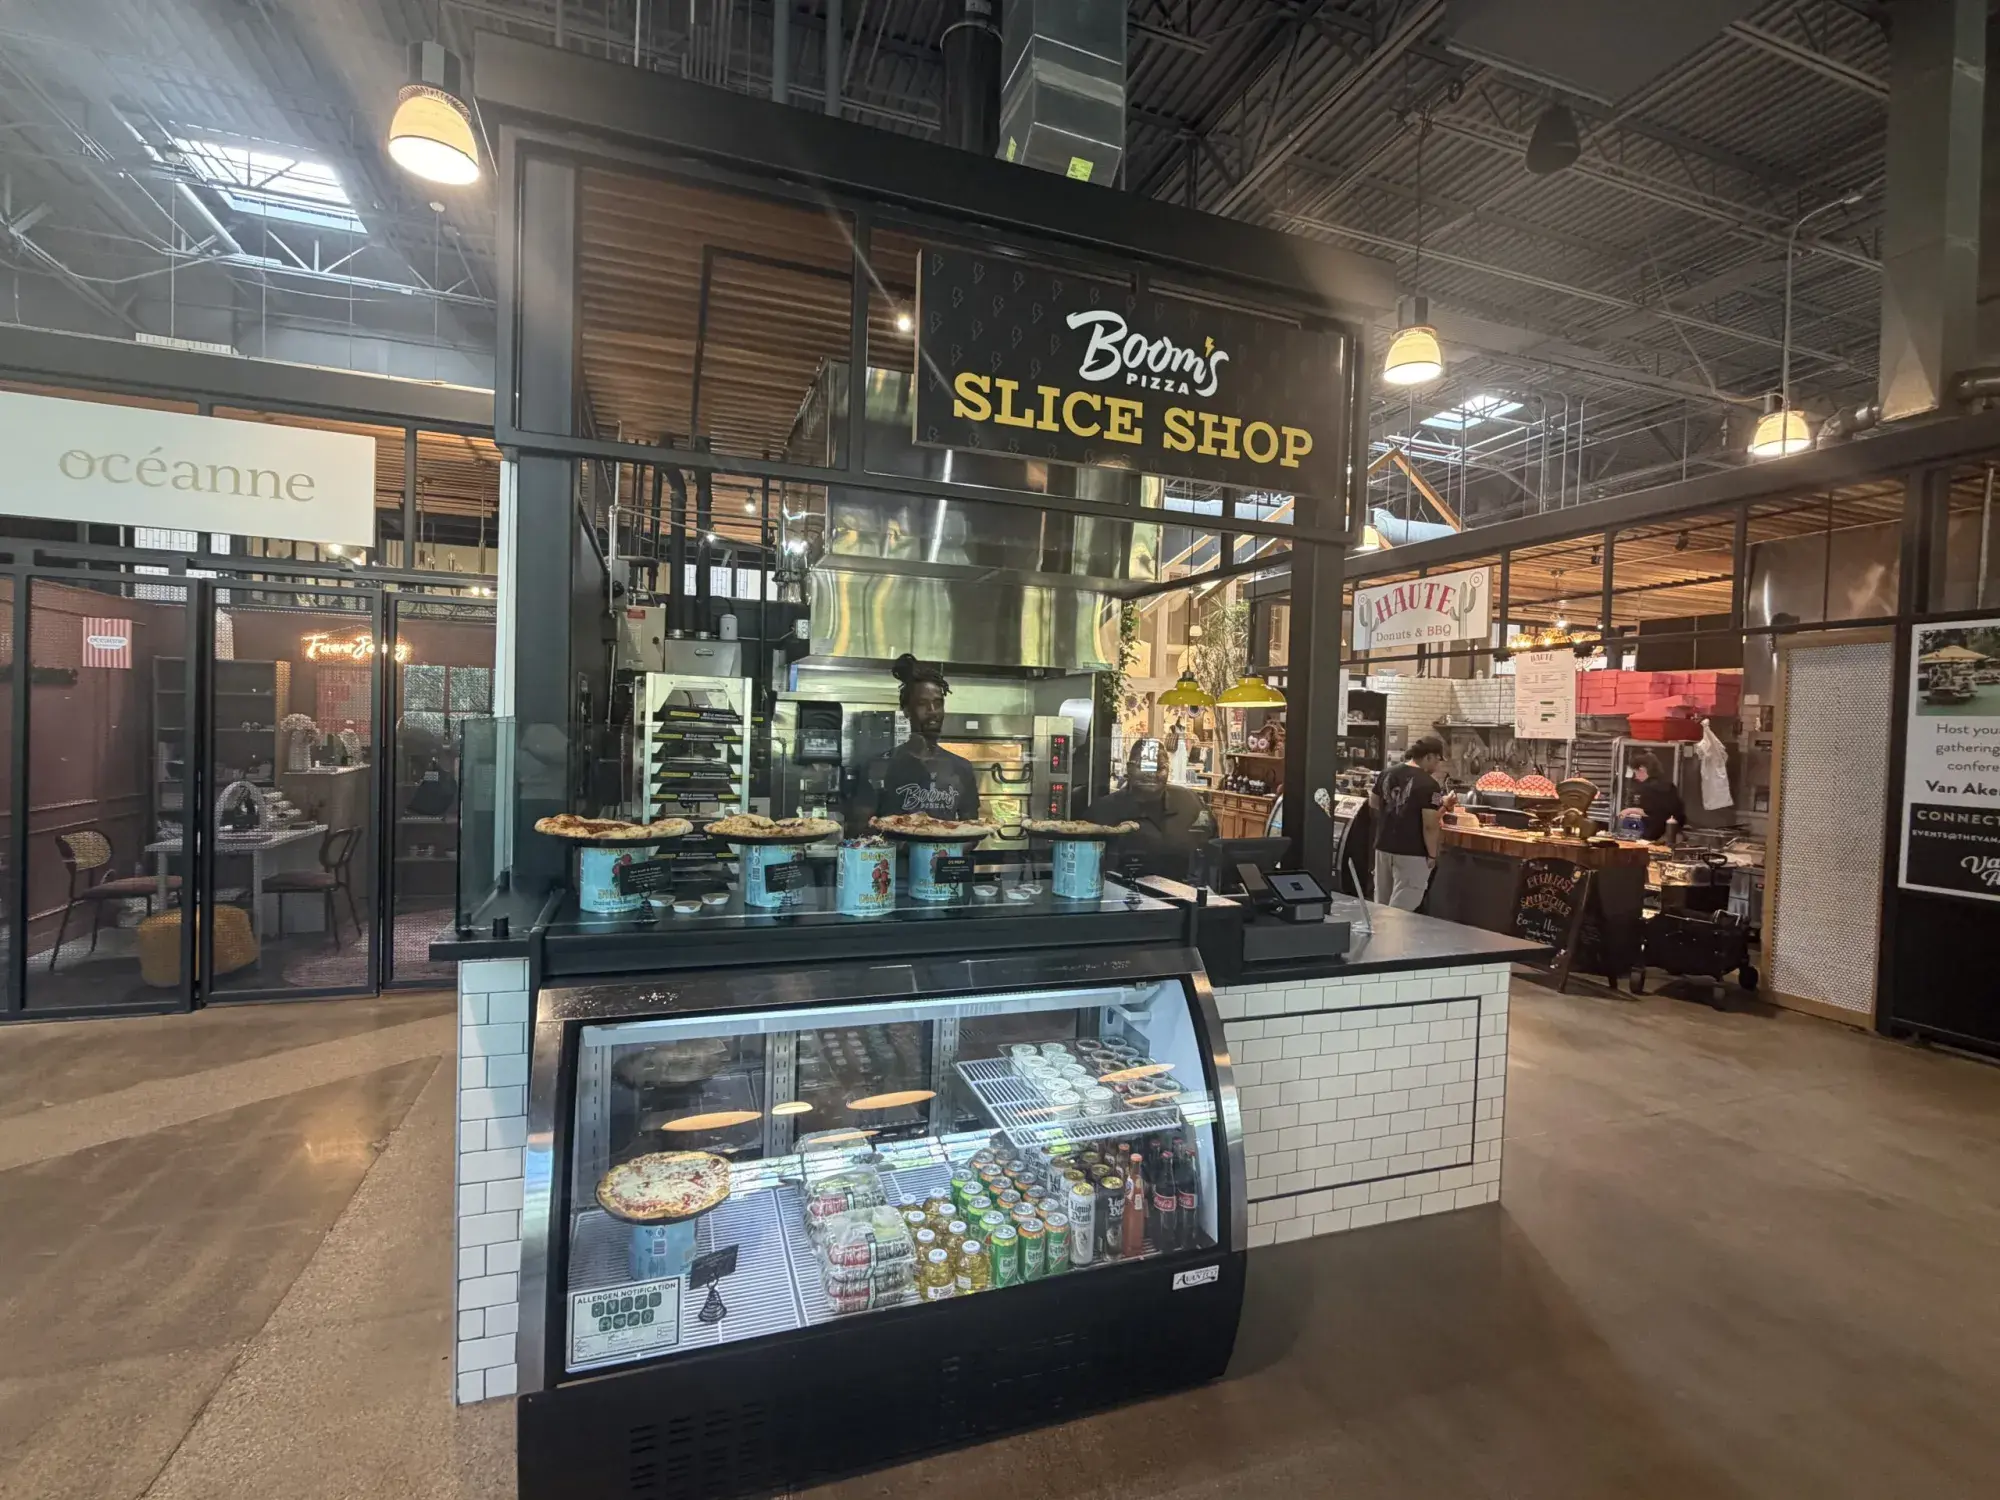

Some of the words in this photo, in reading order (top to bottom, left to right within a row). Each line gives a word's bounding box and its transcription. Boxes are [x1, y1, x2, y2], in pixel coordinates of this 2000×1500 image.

[1066, 310, 1229, 397] Boom's
[1126, 372, 1190, 395] PIZZA
[953, 372, 1143, 445] SLICE
[1163, 406, 1314, 469] SHOP
[58, 446, 316, 503] océanne
[1375, 581, 1456, 624] HAUTE
[1375, 628, 1412, 643] Donuts
[1414, 628, 1423, 637] &
[1427, 624, 1451, 638] BBQ
[1936, 723, 1969, 734] Host
[1973, 727, 2000, 738] you
[1925, 780, 1957, 794] Van
[1963, 782, 2000, 796] Ake
[577, 1291, 619, 1304] ALLERGEN
[620, 1282, 676, 1297] NOTIFICATION
